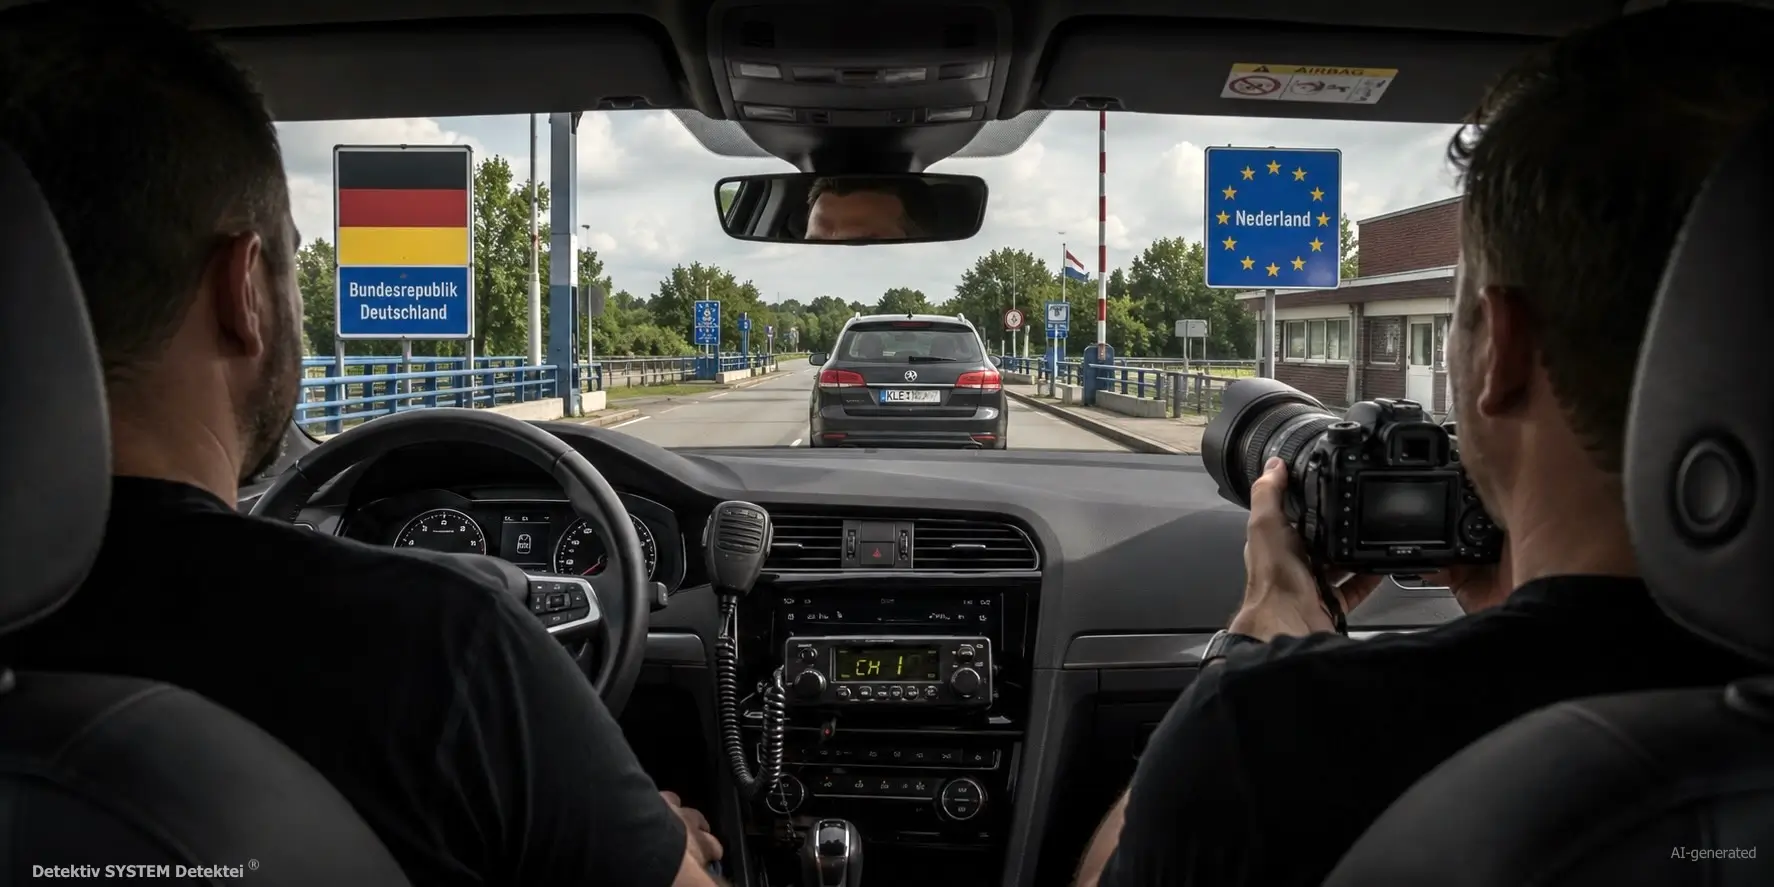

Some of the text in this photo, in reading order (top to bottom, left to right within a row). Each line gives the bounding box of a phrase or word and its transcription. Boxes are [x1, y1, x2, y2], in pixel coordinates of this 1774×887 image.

[1294, 66, 1365, 76] AIRBAG
[1235, 210, 1311, 227] Nederland
[349, 282, 458, 300] Bundesrepublik
[360, 304, 447, 320] Deutschland
[856, 655, 903, 676] CH 1
